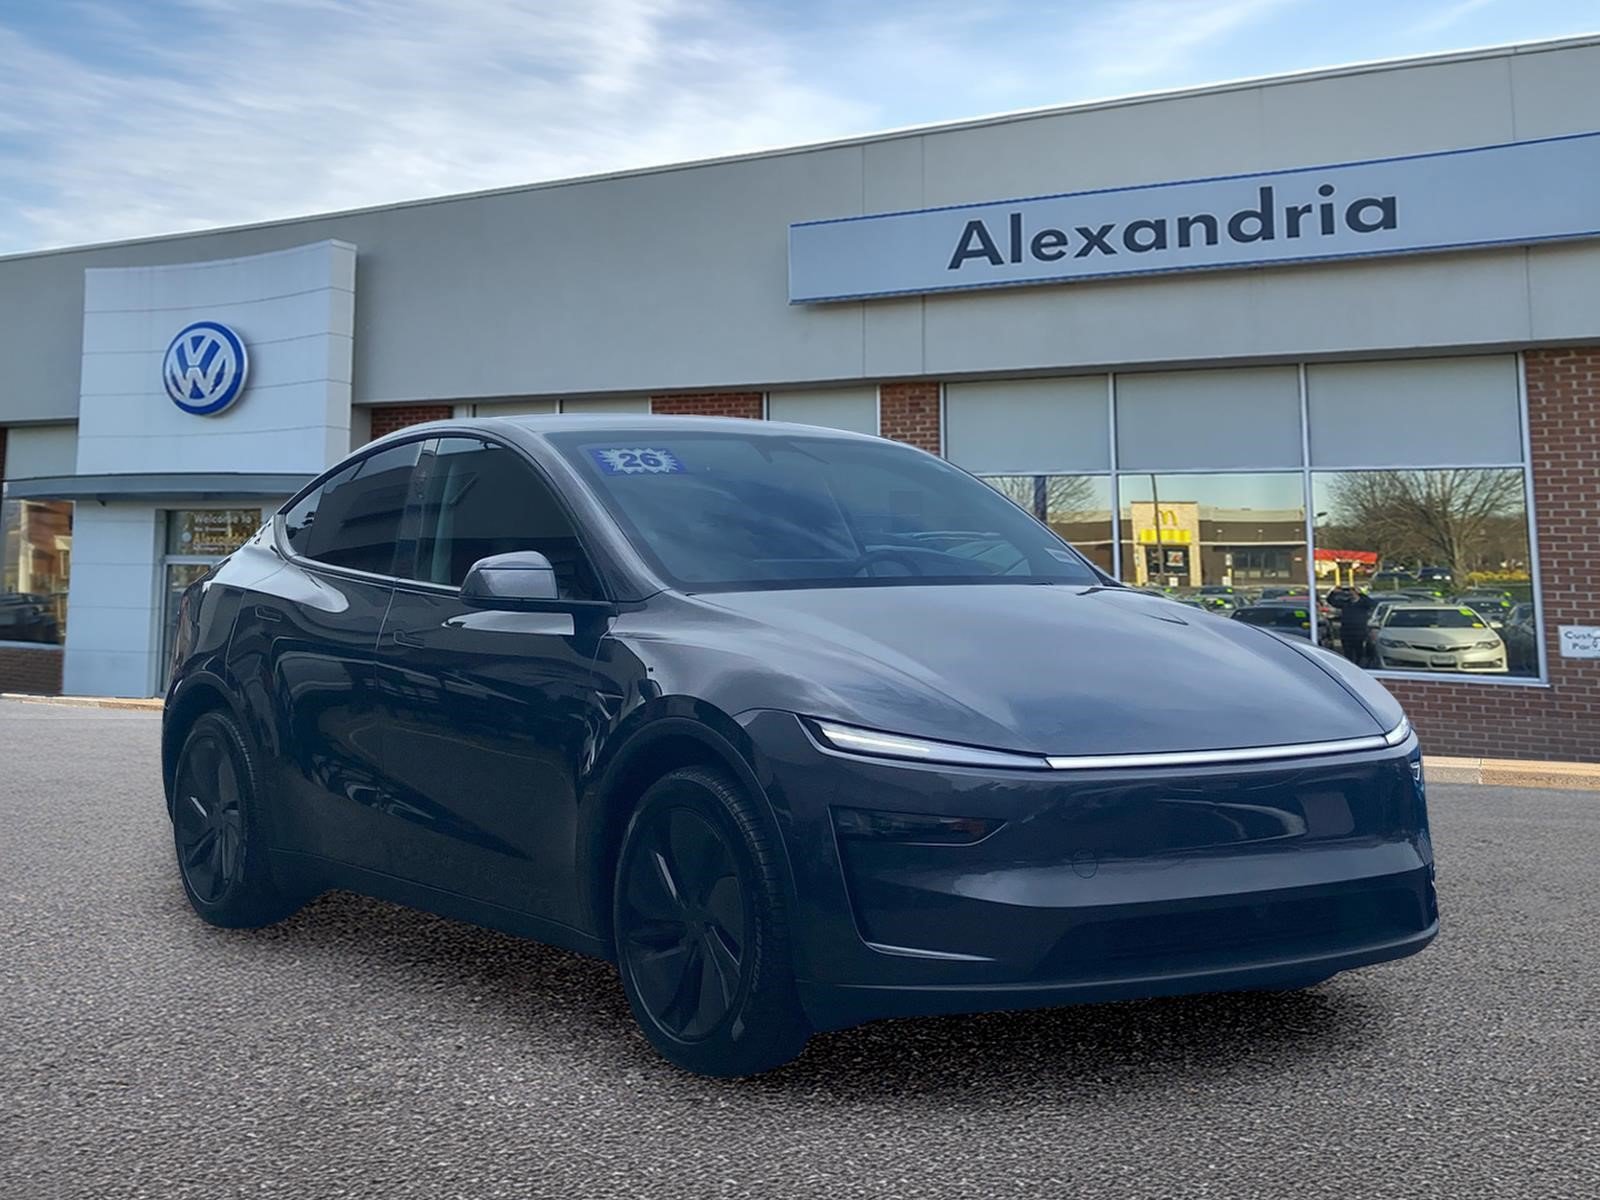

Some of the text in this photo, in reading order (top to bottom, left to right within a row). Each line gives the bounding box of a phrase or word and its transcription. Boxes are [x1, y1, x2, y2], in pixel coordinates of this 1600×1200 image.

[947, 184, 1398, 270] Alexandria
[165, 328, 237, 407] VW
[618, 452, 663, 468] 26
